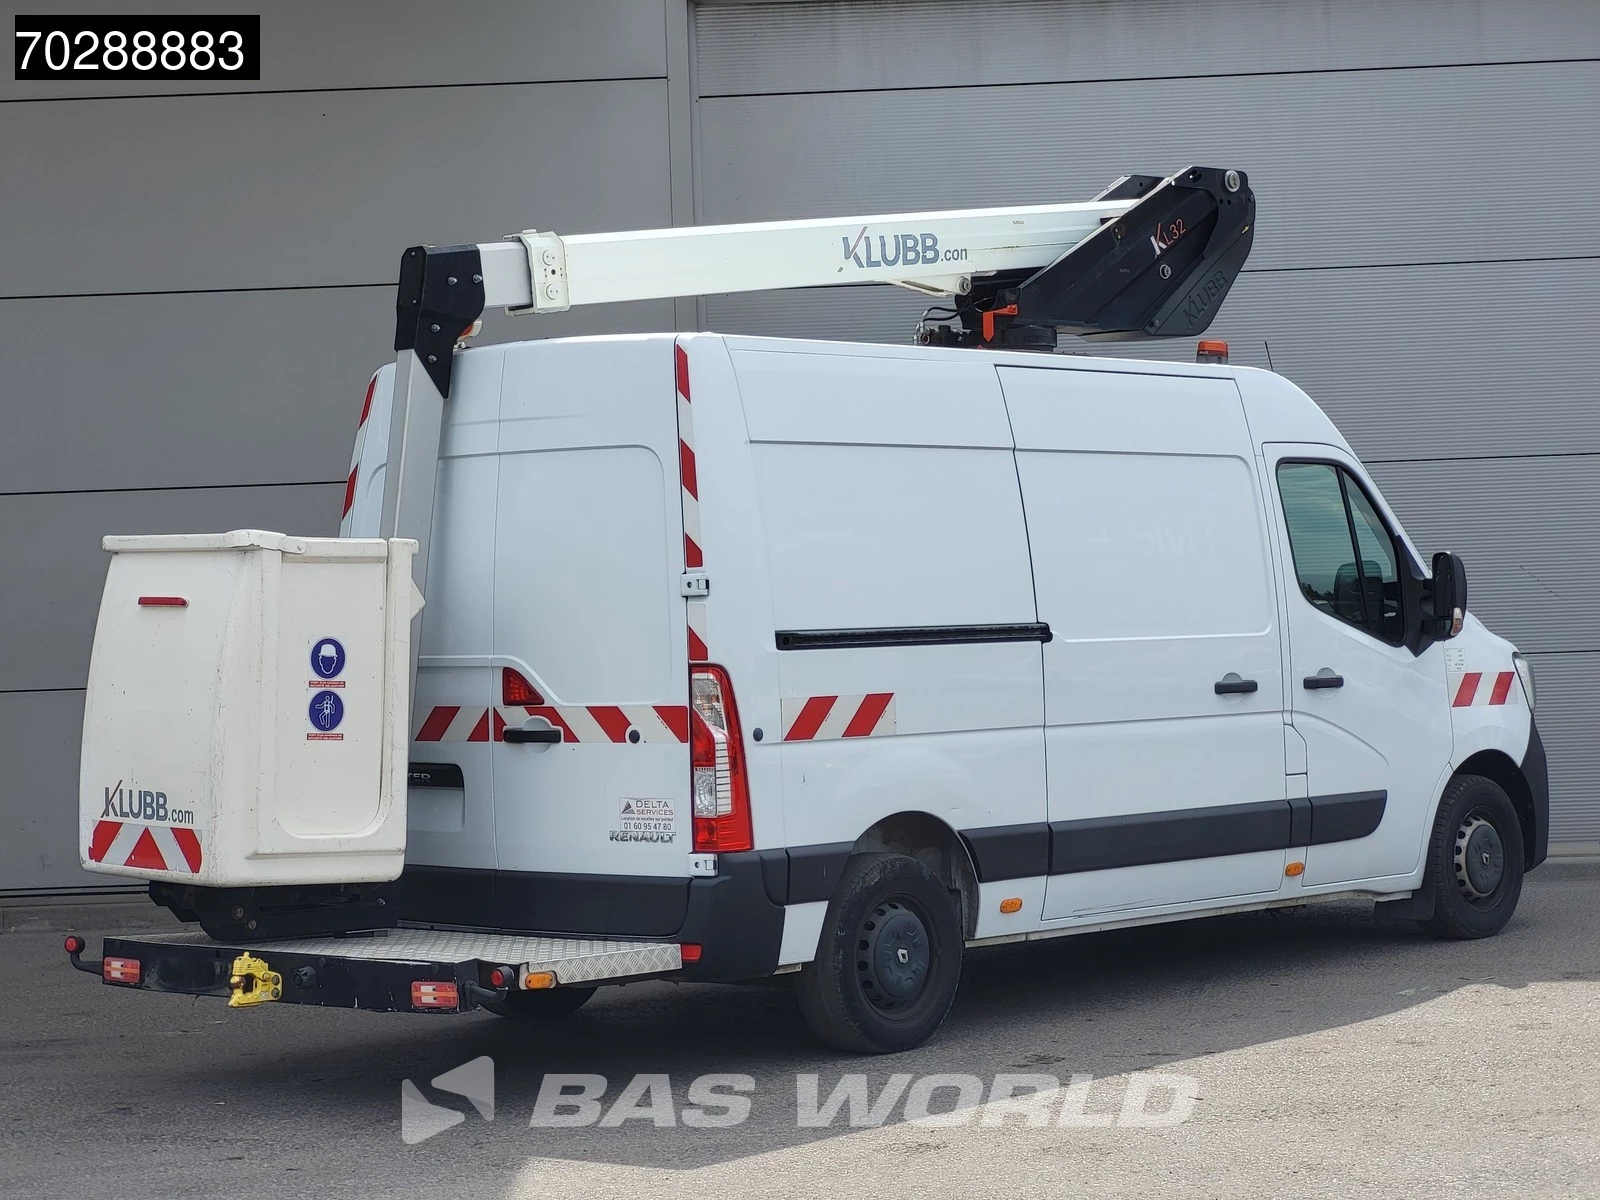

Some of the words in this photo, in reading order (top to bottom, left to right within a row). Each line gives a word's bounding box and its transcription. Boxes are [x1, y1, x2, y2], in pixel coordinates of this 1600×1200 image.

[1182, 270, 1228, 327] KLUBB
[101, 779, 194, 825] KLUBB.com
[635, 800, 669, 809] DELTA
[624, 822, 631, 830] 01
[633, 822, 642, 830] 60
[609, 830, 676, 843] RENAULT
